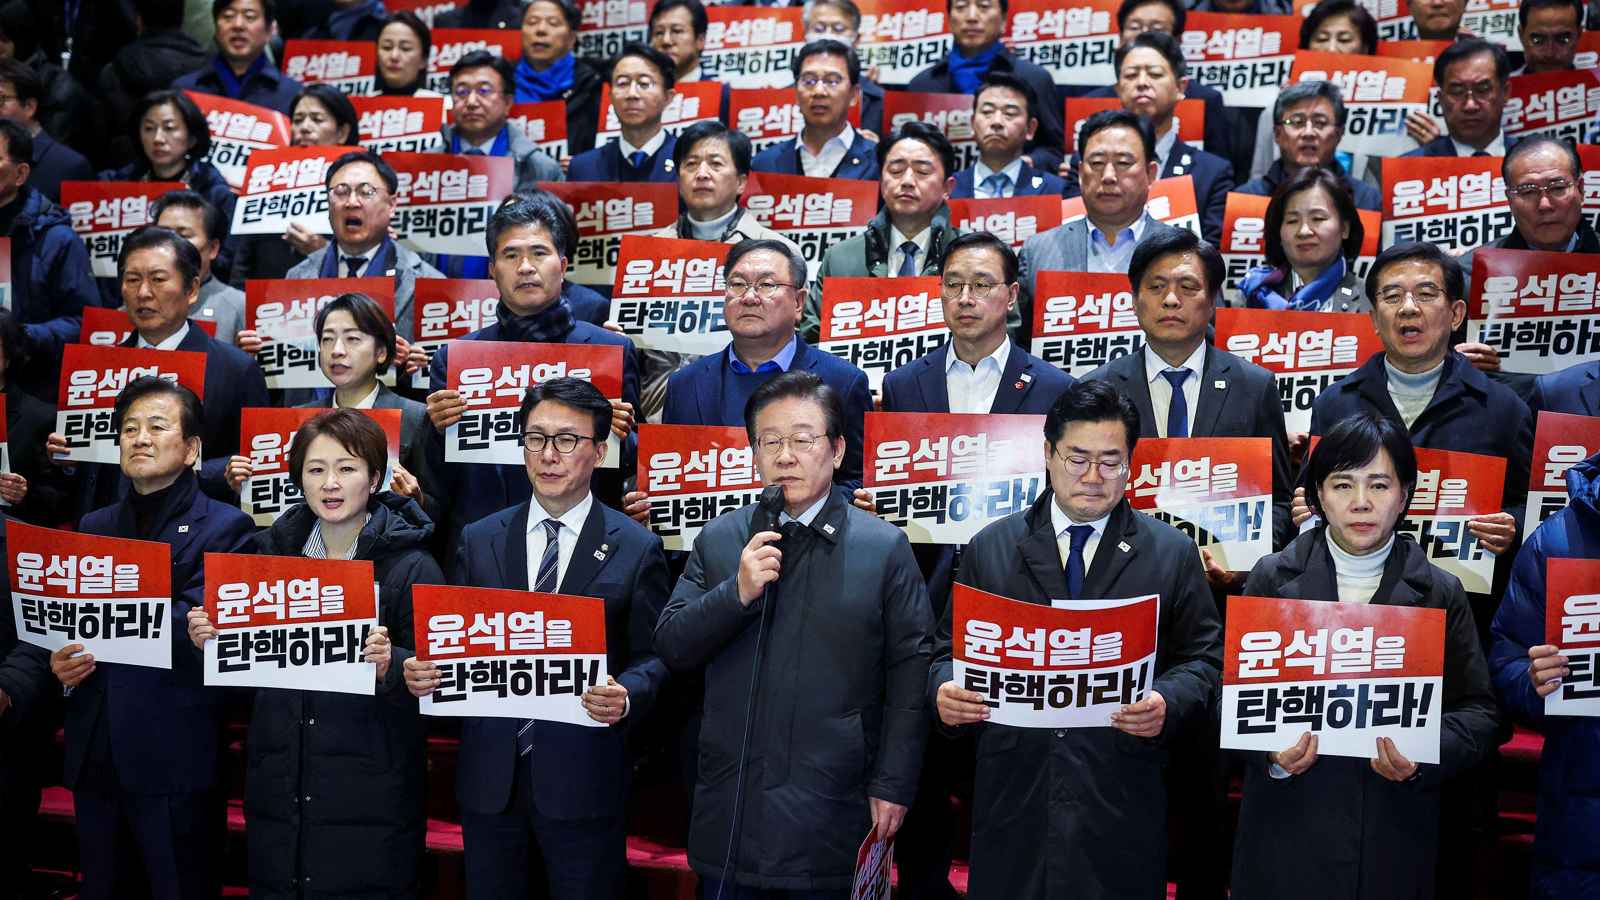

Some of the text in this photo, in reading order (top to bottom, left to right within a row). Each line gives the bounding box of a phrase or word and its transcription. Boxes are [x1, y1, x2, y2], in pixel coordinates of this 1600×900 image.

[1012, 7, 1110, 41] 윤석열을
[1181, 27, 1281, 60] 윤석열을
[700, 48, 797, 78] 탄핵하라
[856, 39, 948, 70] 탄핵하라
[206, 110, 273, 142] 석열을
[357, 108, 425, 139] 석열을
[248, 157, 333, 195] 윤석열
[70, 195, 154, 232] 윤석열
[390, 206, 495, 240] 탄핵하라
[571, 196, 655, 232] 석열을
[748, 191, 853, 227] 윤석열을
[1481, 272, 1600, 315] 윤석열
[649, 446, 760, 492] 윤석열
[1126, 456, 1238, 498] 석열을
[17, 552, 140, 594] 윤석열을
[21, 598, 165, 640] 탄핵하라!
[217, 577, 344, 625] 윤석열을
[217, 624, 371, 673] 탄핵하라!
[427, 611, 572, 655] 윤석열을
[964, 619, 1123, 666] 윤석열을
[1238, 626, 1405, 678] 윤석열을
[963, 660, 1148, 711] 탄핵하라!
[1236, 682, 1434, 735] 탄핵하라!
